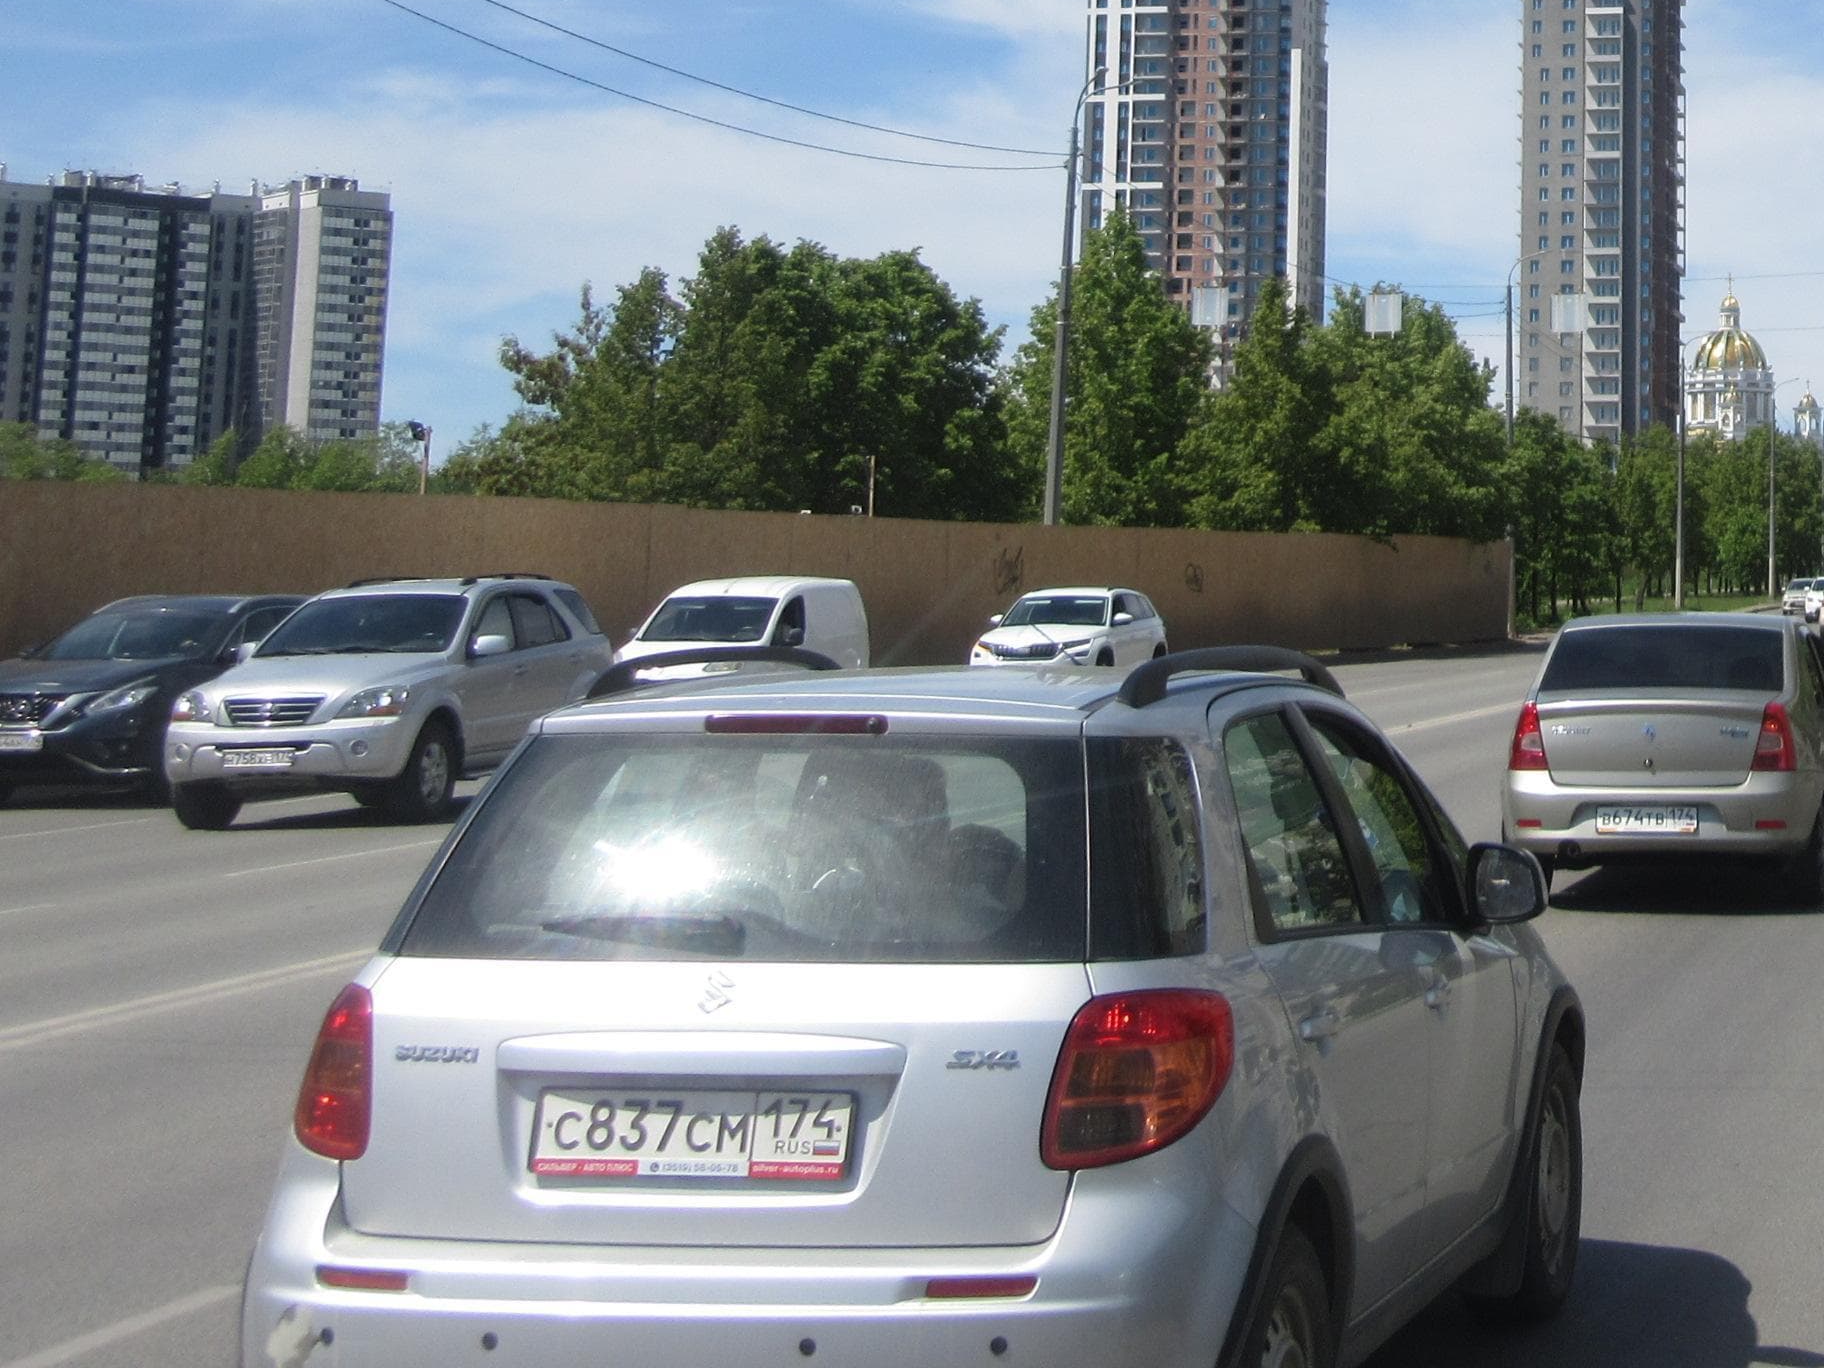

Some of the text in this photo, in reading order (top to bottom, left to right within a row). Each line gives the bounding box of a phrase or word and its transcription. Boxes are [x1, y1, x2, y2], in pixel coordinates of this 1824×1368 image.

[395, 1045, 480, 1064] SUZUKI
[945, 1049, 1021, 1070] SX4
[554, 1097, 836, 1153] С837СМ 174
[774, 1139, 811, 1155] RUS
[751, 1164, 840, 1176] silver-autoplus.ru
